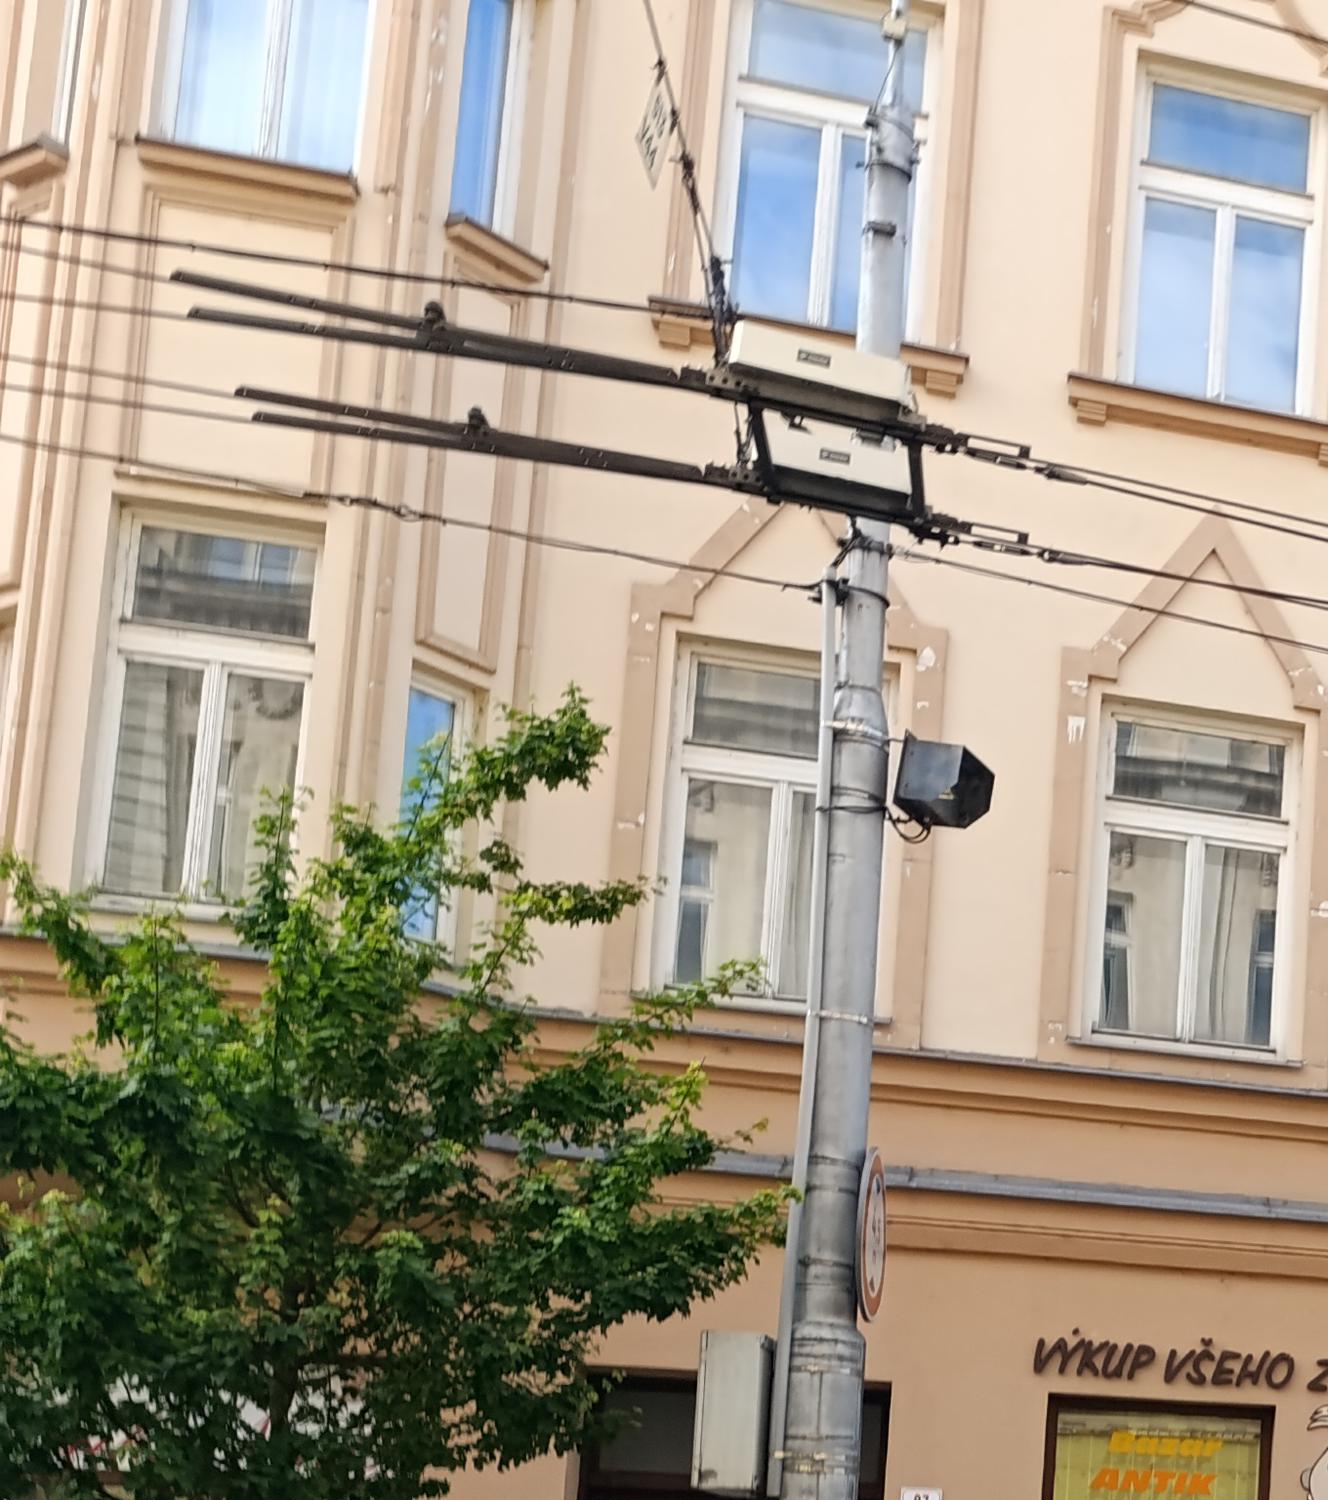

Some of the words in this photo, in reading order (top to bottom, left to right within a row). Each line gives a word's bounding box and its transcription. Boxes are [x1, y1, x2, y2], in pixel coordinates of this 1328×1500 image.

[1033, 1328, 1156, 1381] VÝKUP
[1164, 1337, 1295, 1389] VŠEHO
[1108, 1431, 1224, 1457] Bazar
[1090, 1467, 1217, 1496] ANTIK
